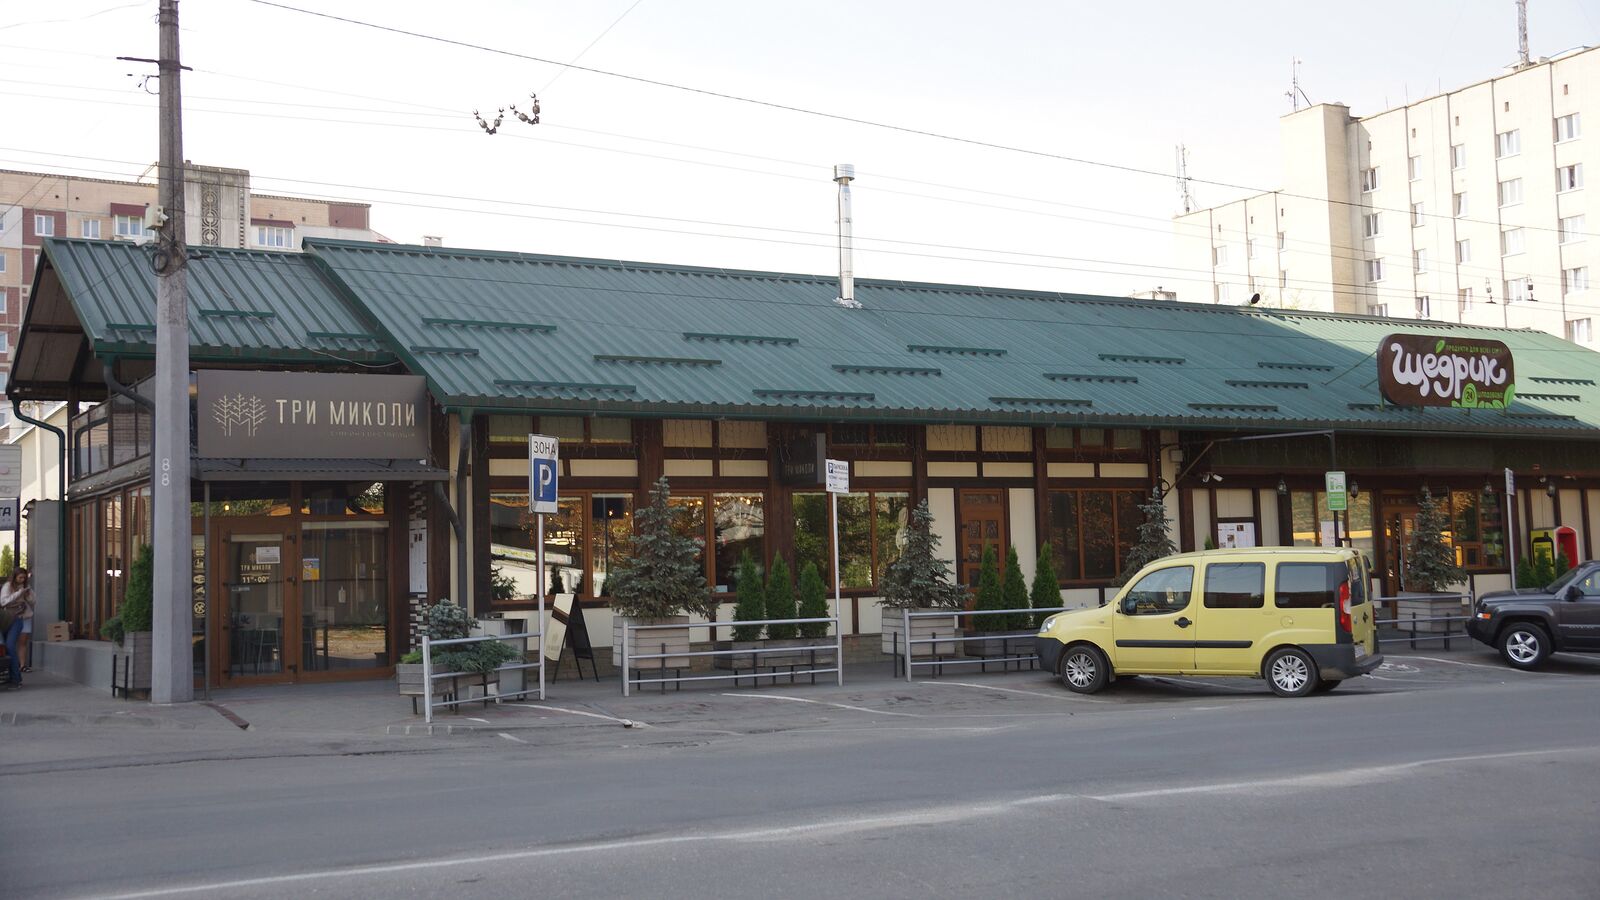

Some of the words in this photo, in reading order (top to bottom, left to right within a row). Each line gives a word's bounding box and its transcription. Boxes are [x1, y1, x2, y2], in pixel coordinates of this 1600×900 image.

[1390, 342, 1507, 399] Щедрик
[275, 399, 316, 424] ТРИ
[330, 400, 415, 426] МИКОЛИ
[533, 441, 556, 456] ЗОНА
[539, 464, 552, 498] P
